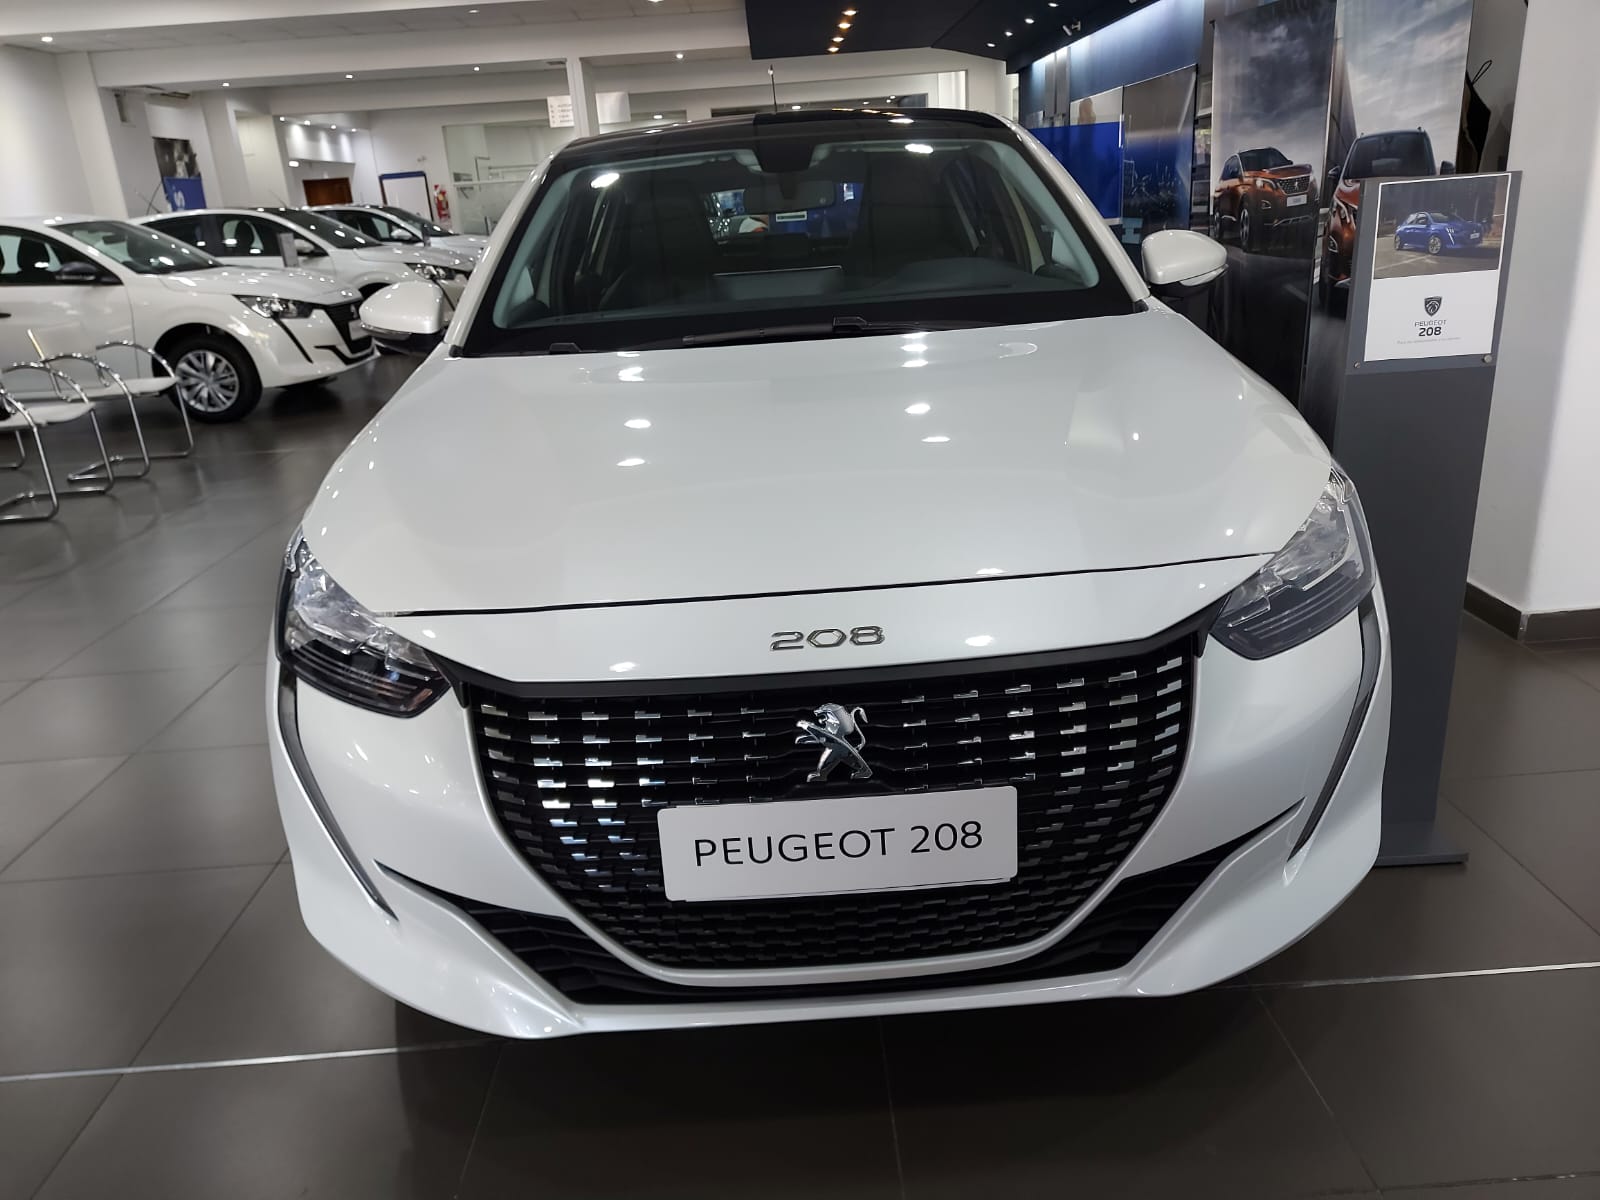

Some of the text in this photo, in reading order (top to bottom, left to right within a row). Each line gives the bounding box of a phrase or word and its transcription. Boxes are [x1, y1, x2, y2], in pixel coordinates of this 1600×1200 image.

[1418, 326, 1442, 337] 208
[770, 625, 886, 651] 208
[694, 820, 983, 867] PEUGEOT 208
